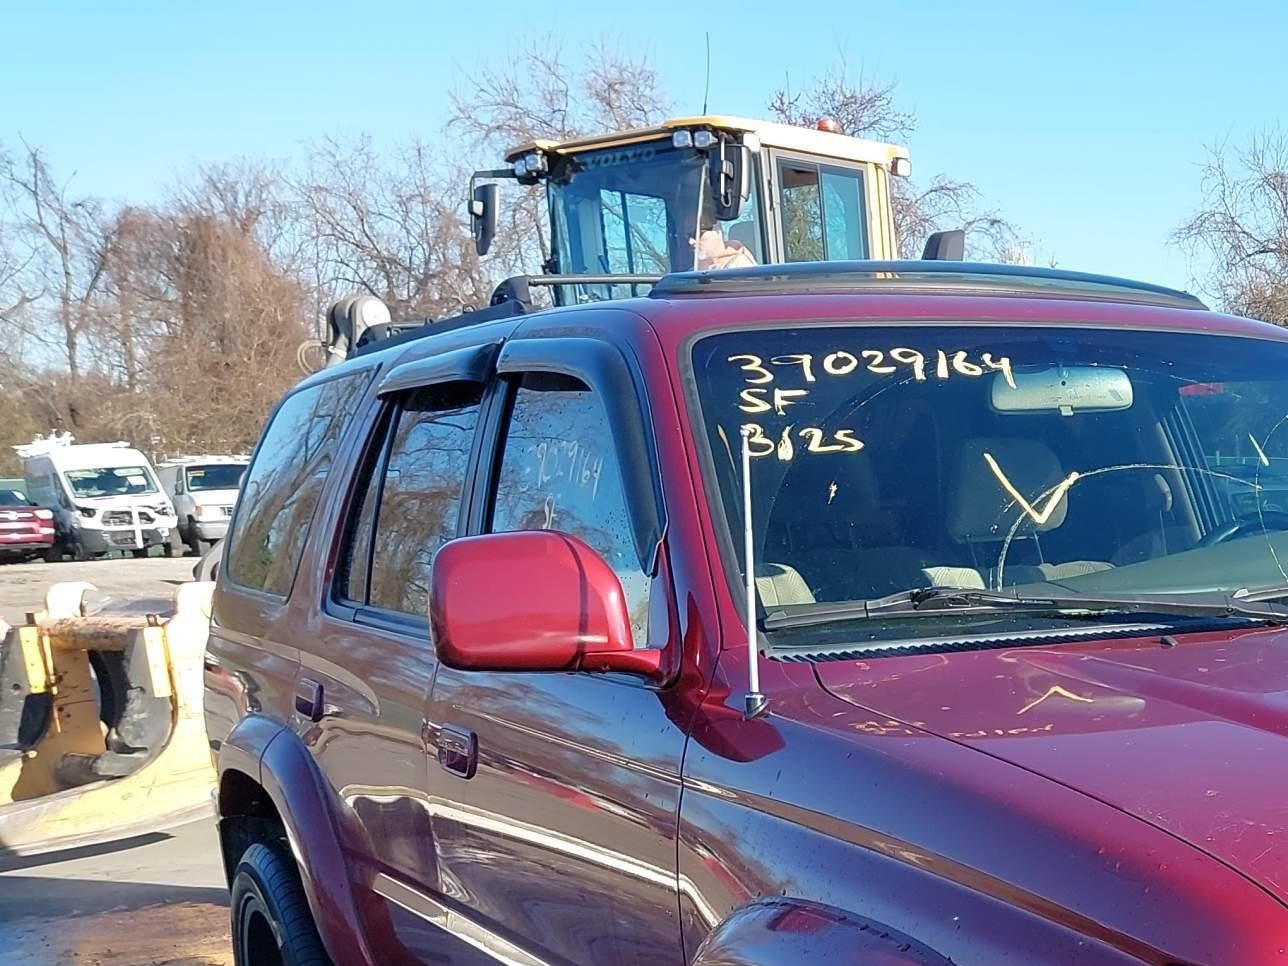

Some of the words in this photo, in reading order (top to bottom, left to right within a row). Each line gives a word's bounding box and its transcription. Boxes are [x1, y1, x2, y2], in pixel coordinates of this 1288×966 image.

[585, 147, 656, 169] VOLVO
[728, 347, 1016, 389] 39029164
[738, 387, 809, 416] SF
